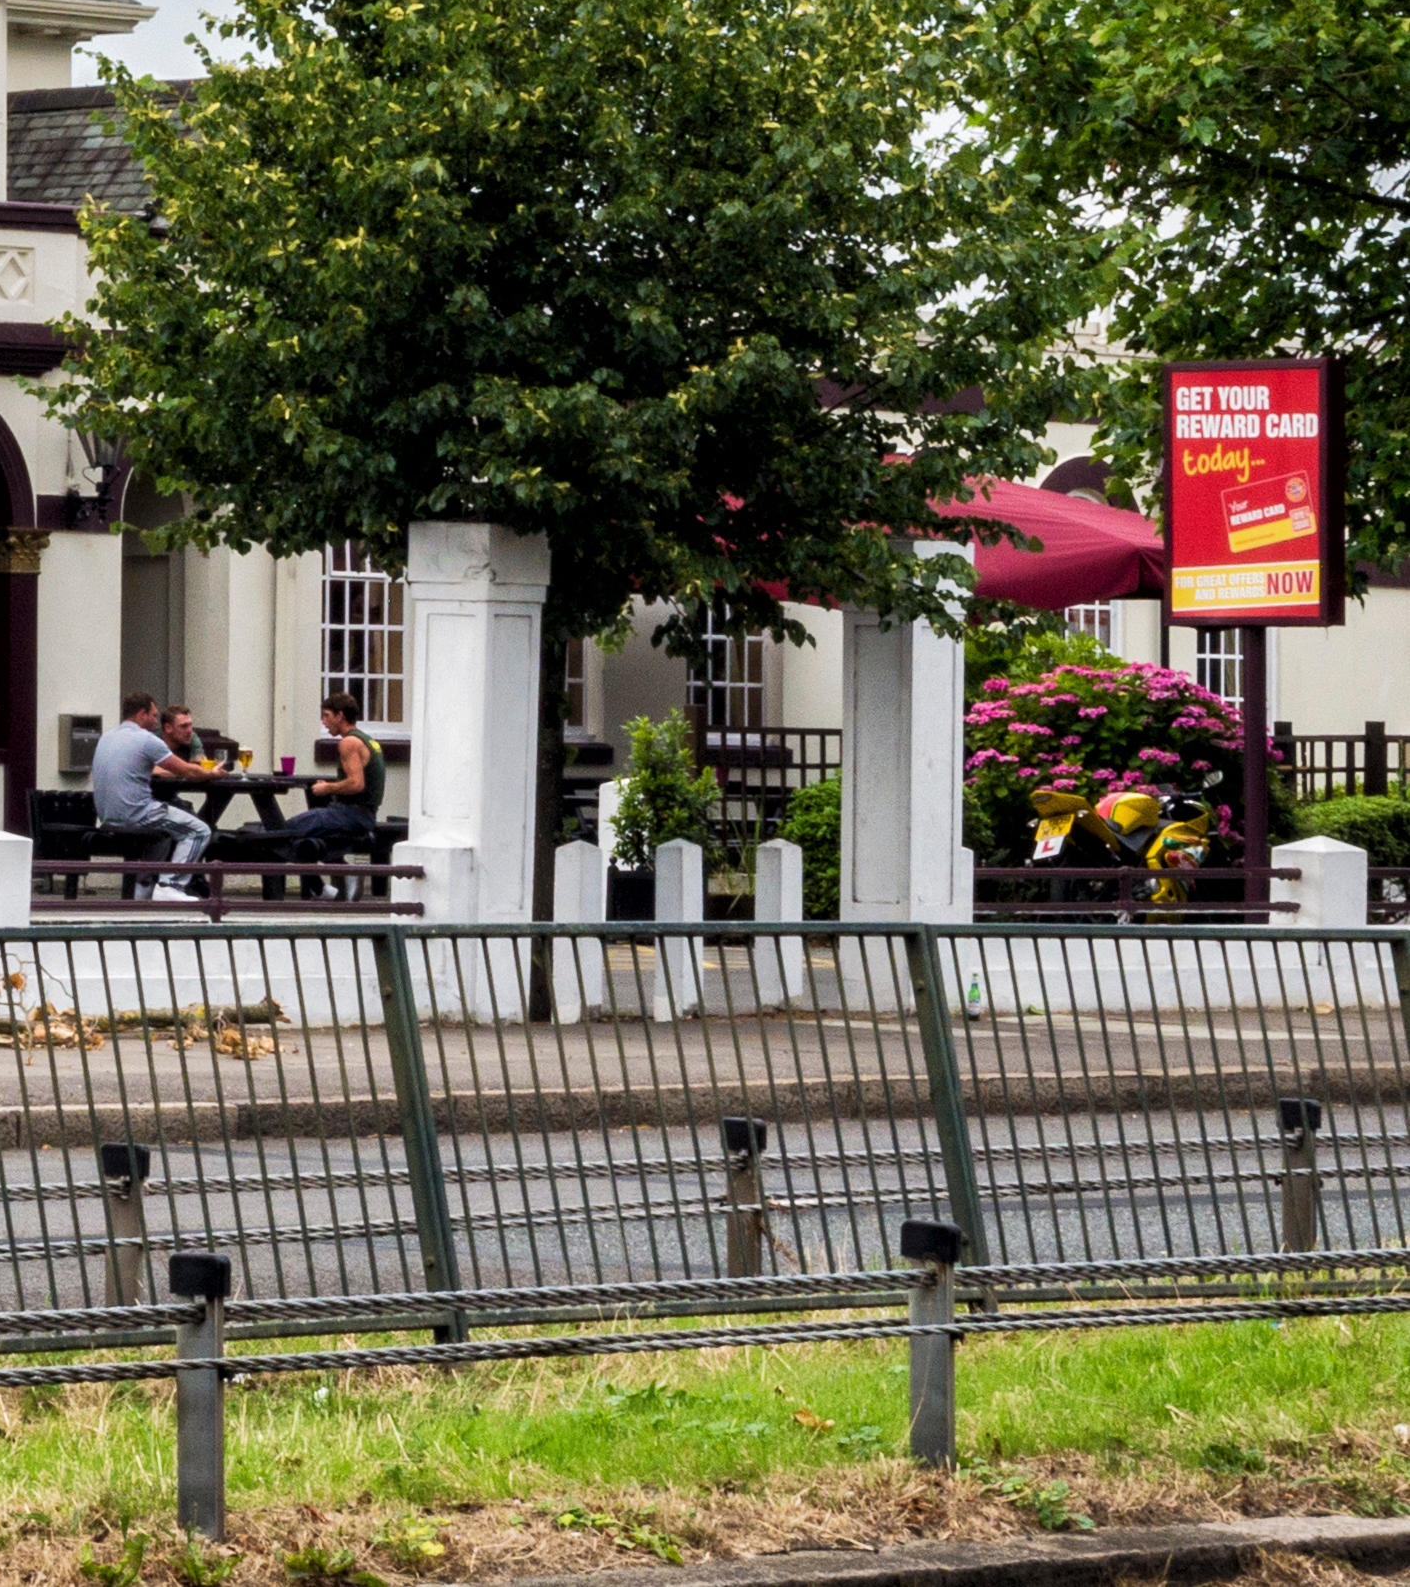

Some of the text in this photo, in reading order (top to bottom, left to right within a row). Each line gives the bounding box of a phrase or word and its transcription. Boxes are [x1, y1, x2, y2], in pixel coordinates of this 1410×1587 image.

[1175, 385, 1270, 411] GET YOUR
[1176, 413, 1319, 439] REWARD CARD
[1182, 442, 1266, 483] today...
[1174, 572, 1264, 589] FOR GREAT OFFERS
[1267, 570, 1314, 596] NOW
[1042, 841, 1054, 853] L
